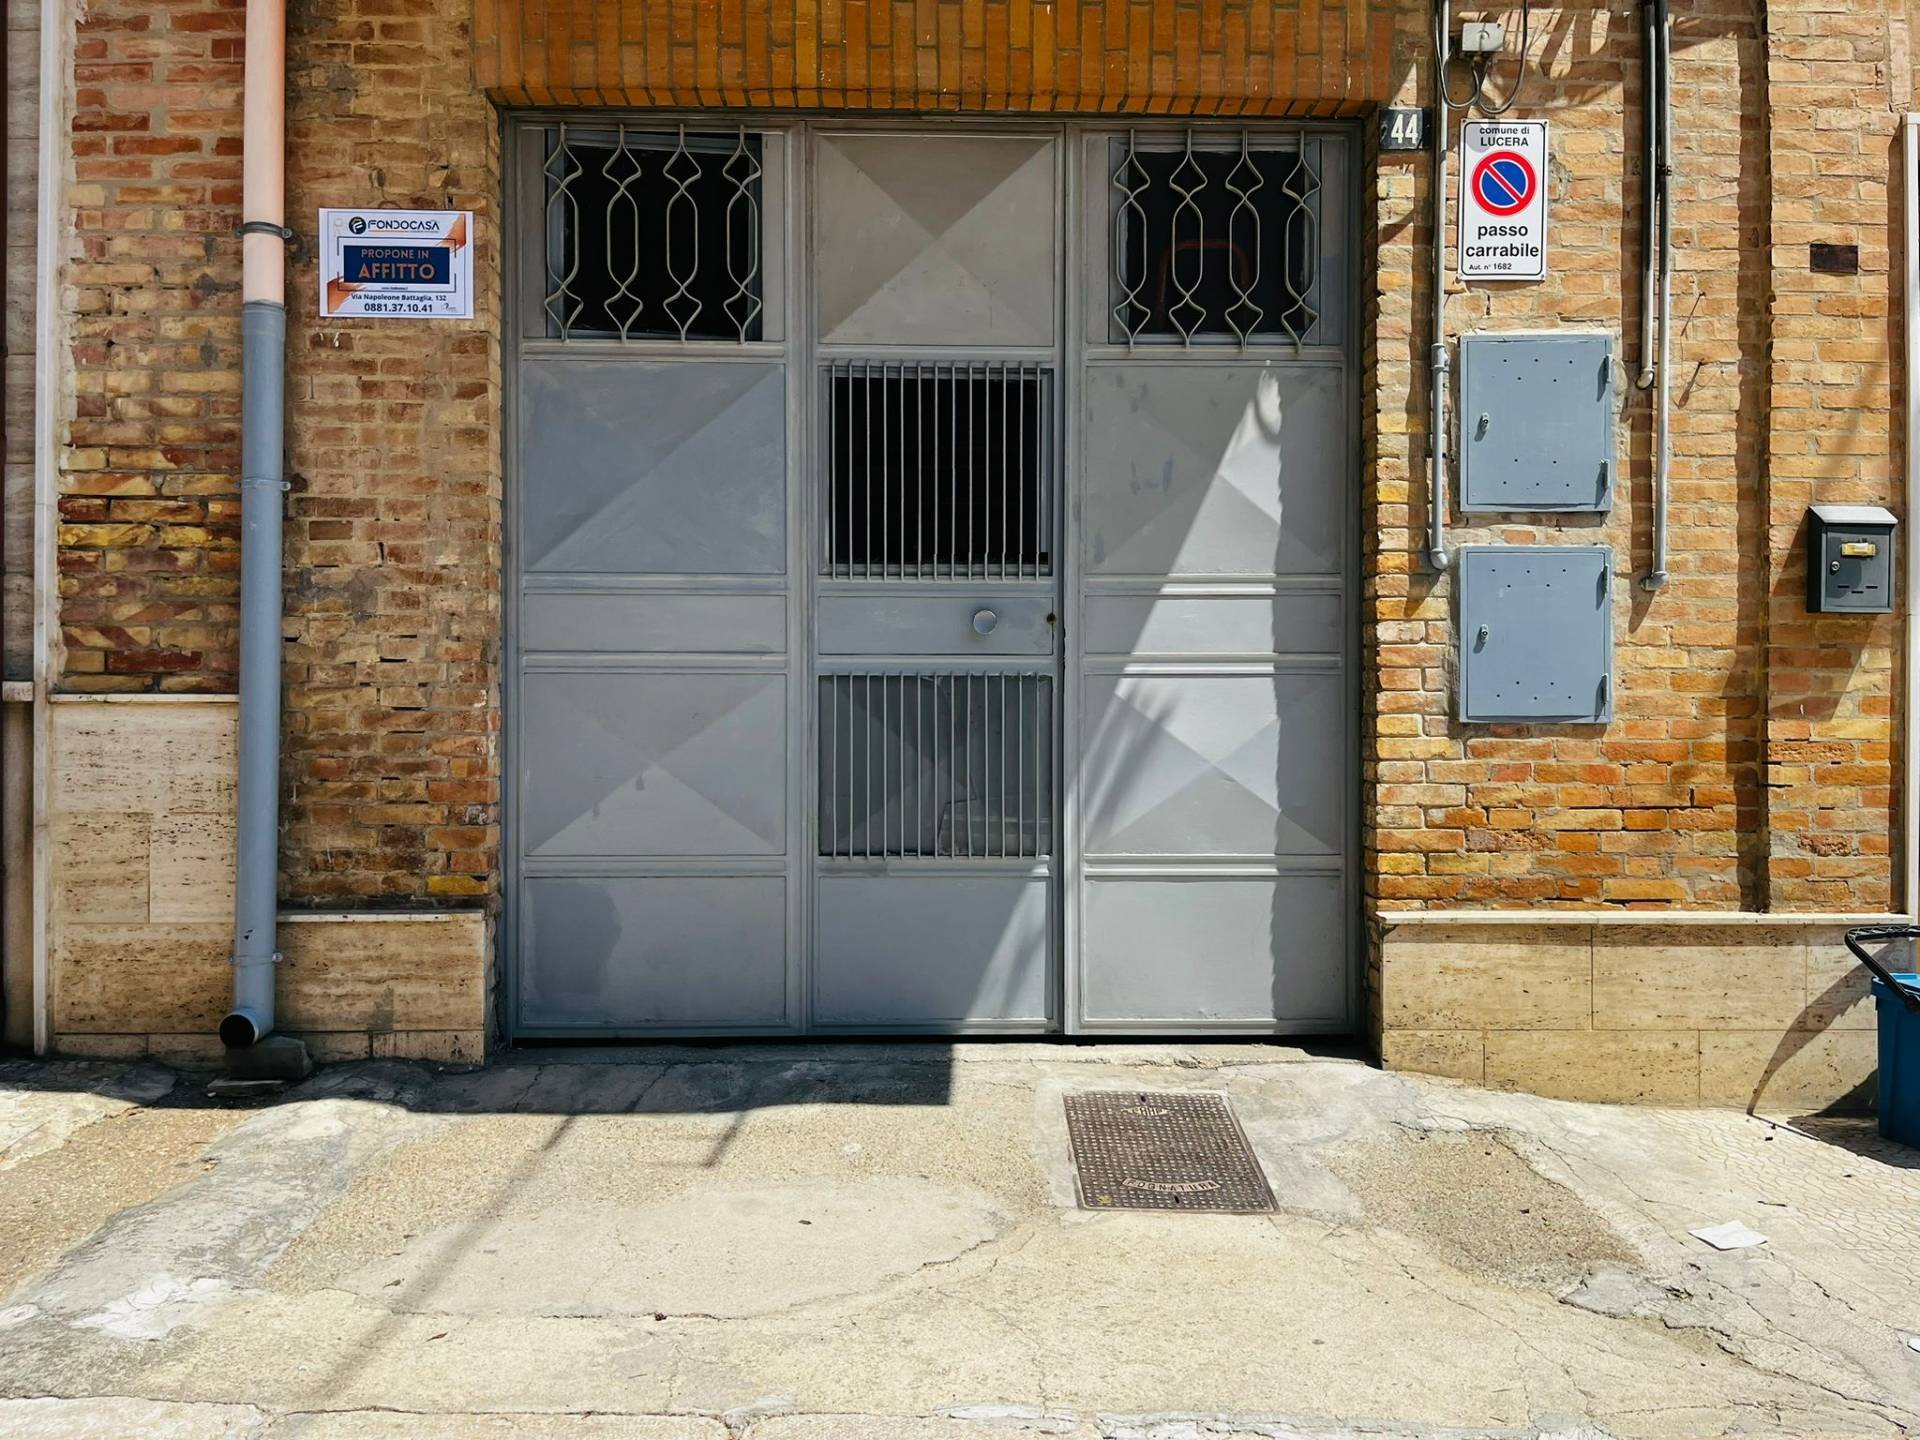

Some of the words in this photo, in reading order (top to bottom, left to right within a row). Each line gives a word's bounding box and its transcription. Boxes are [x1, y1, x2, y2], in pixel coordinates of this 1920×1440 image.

[1391, 114, 1418, 143] 44
[1480, 127, 1518, 135] comune
[1520, 126, 1530, 134] di
[1480, 137, 1529, 147] LUCERA
[368, 220, 440, 230] FONDOCASA
[1477, 225, 1528, 239] passo
[361, 249, 414, 259] PROPONE
[417, 249, 429, 259] IN
[1465, 243, 1539, 257] carrabile
[358, 263, 435, 280] AFFITTO
[364, 294, 400, 302] Napoleone
[364, 303, 433, 312] 0881.37.10.41
